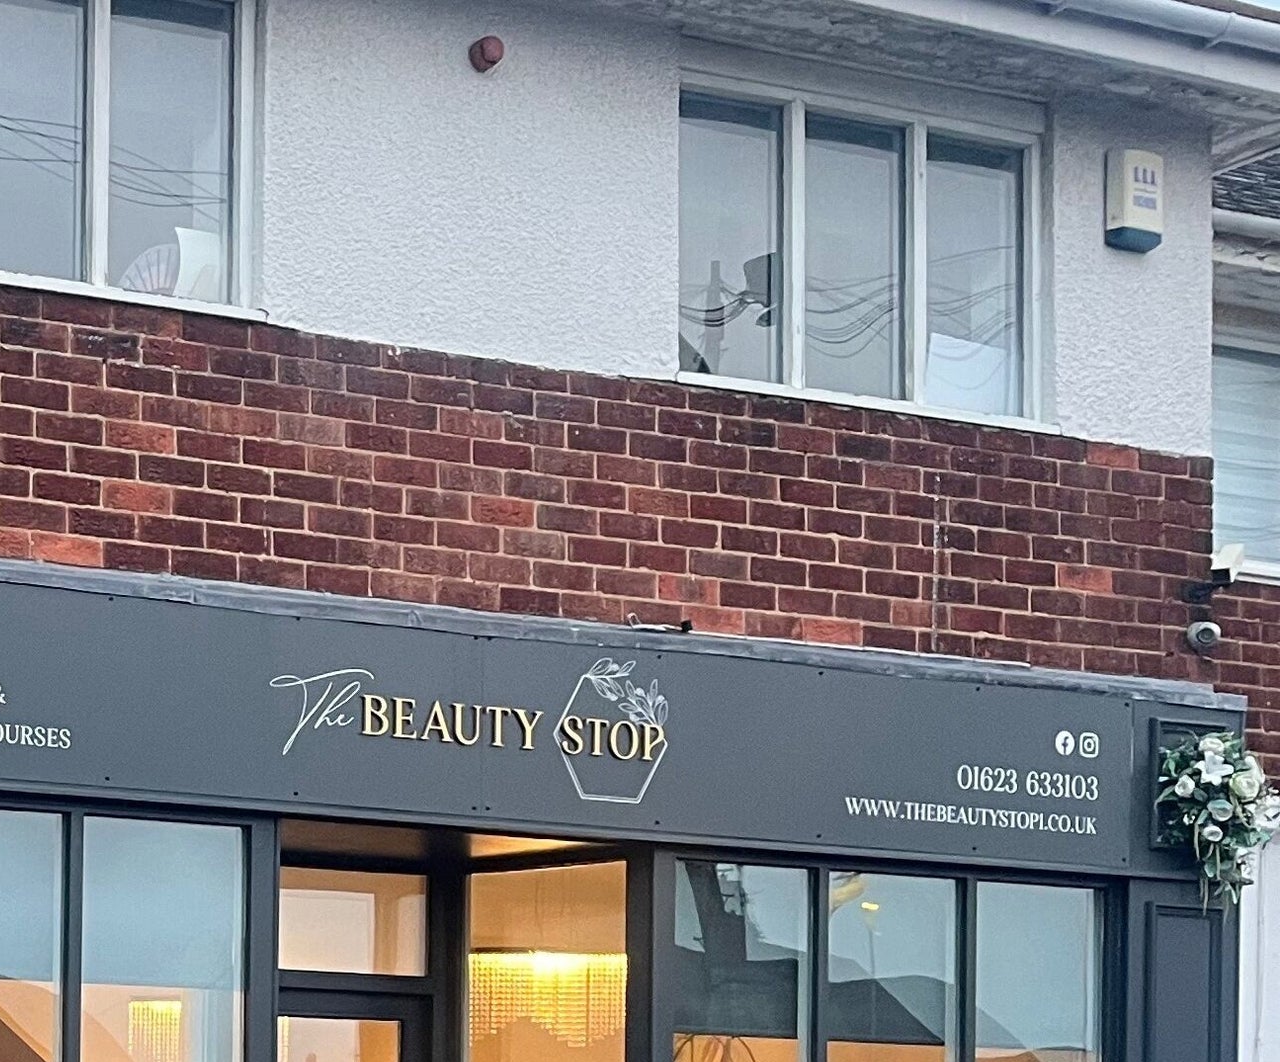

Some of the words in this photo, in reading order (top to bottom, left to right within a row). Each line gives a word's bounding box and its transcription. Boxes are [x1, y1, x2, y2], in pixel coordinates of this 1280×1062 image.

[269, 668, 374, 756] The
[361, 694, 544, 751] BEAUTY
[559, 715, 665, 761] STOP
[957, 764, 1018, 794] 01623
[1025, 770, 1099, 801] 633103
